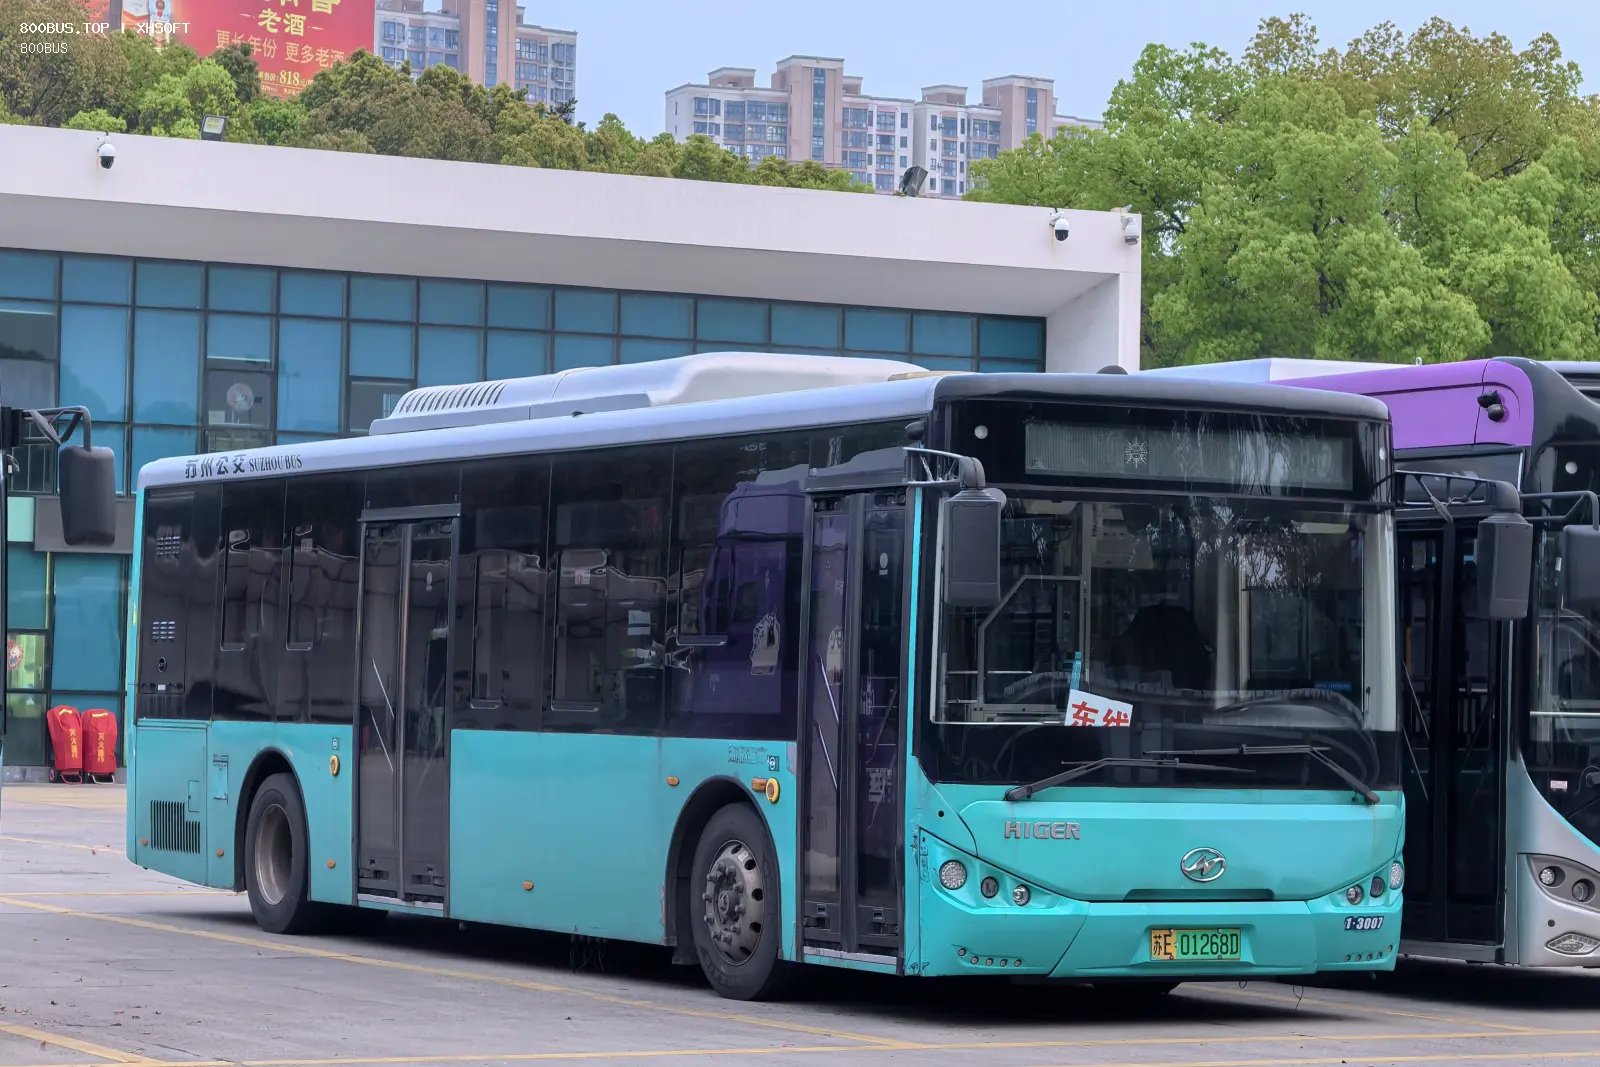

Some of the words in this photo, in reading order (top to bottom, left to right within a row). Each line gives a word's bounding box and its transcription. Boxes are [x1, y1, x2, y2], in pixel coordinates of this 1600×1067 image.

[258, 8, 306, 36] 老酒
[185, 453, 247, 478] 苏州公交
[249, 456, 283, 472] SUZHOU
[285, 454, 303, 470] BUS
[1004, 820, 1081, 840] HIGER
